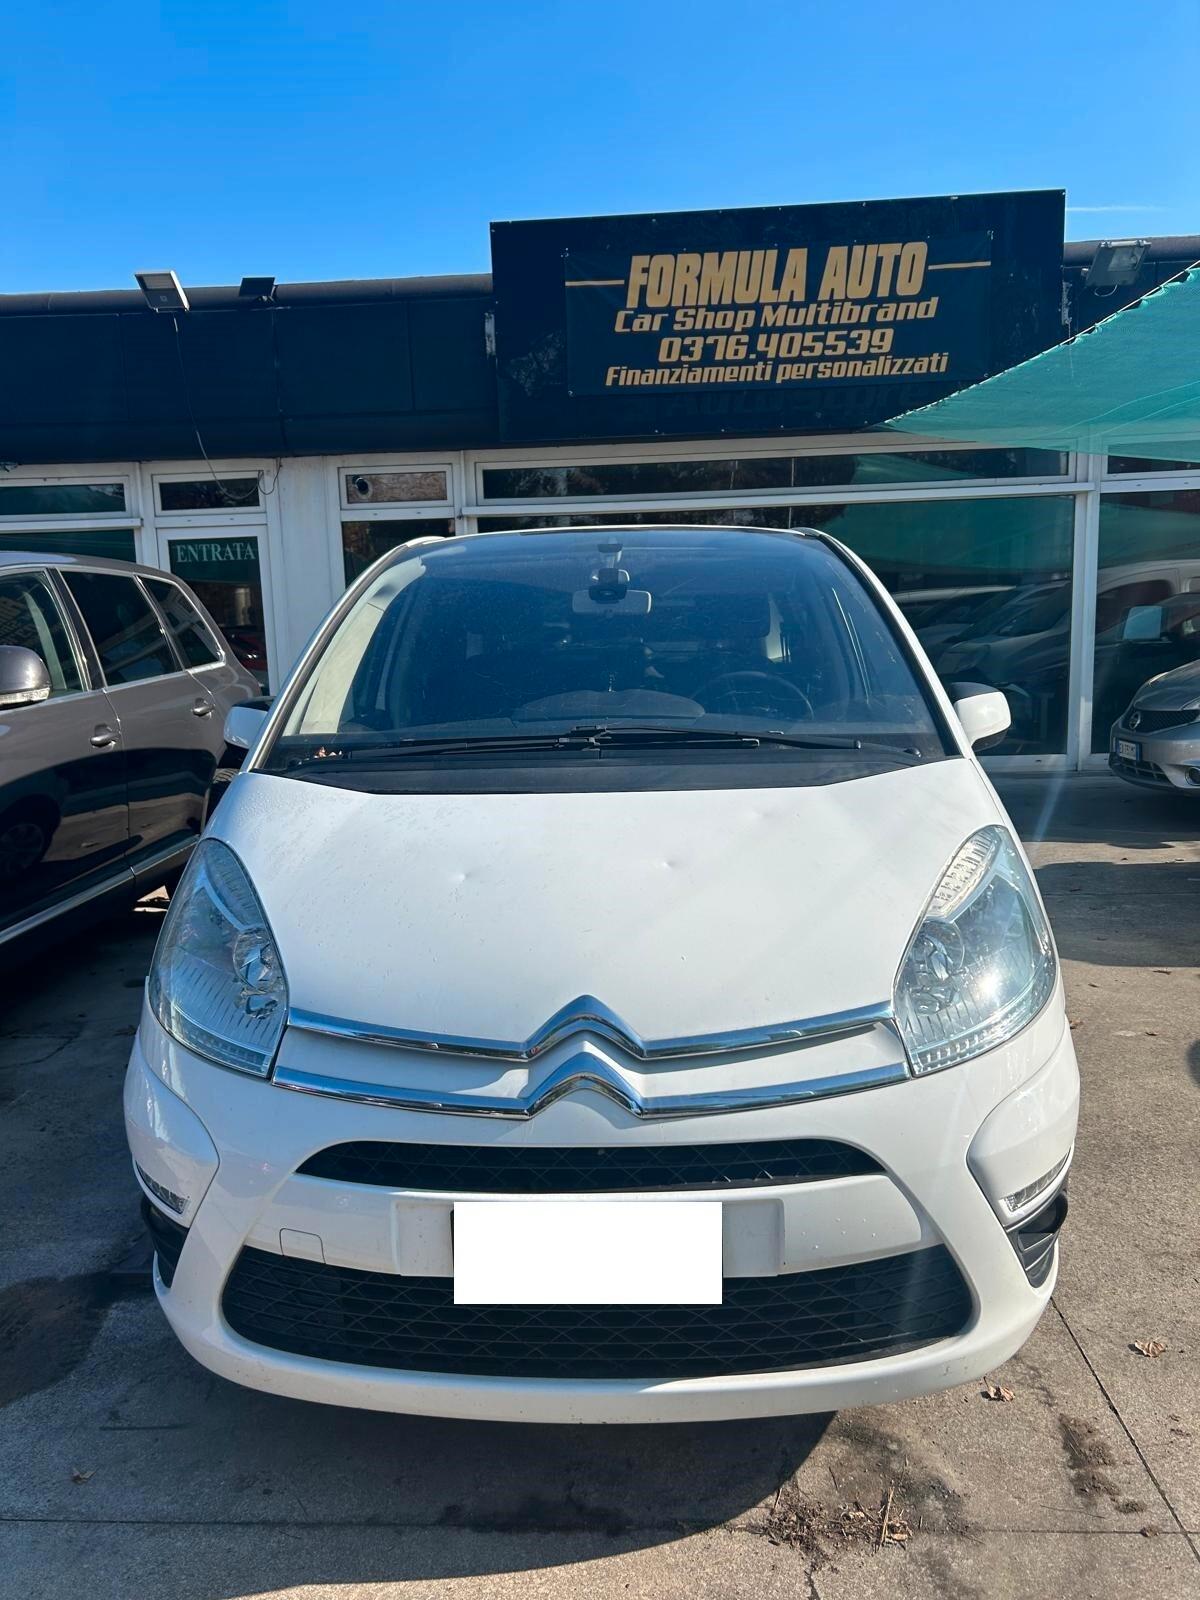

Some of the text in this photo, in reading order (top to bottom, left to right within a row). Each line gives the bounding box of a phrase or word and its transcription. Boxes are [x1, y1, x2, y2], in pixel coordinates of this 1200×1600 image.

[627, 242, 927, 308] FORMULA AUTO
[614, 296, 938, 333] Car Shop Multibrand
[658, 328, 895, 362] 0376.405539
[605, 352, 950, 386] Finanziamenti personalizzati
[176, 542, 256, 562] ENTRATA
